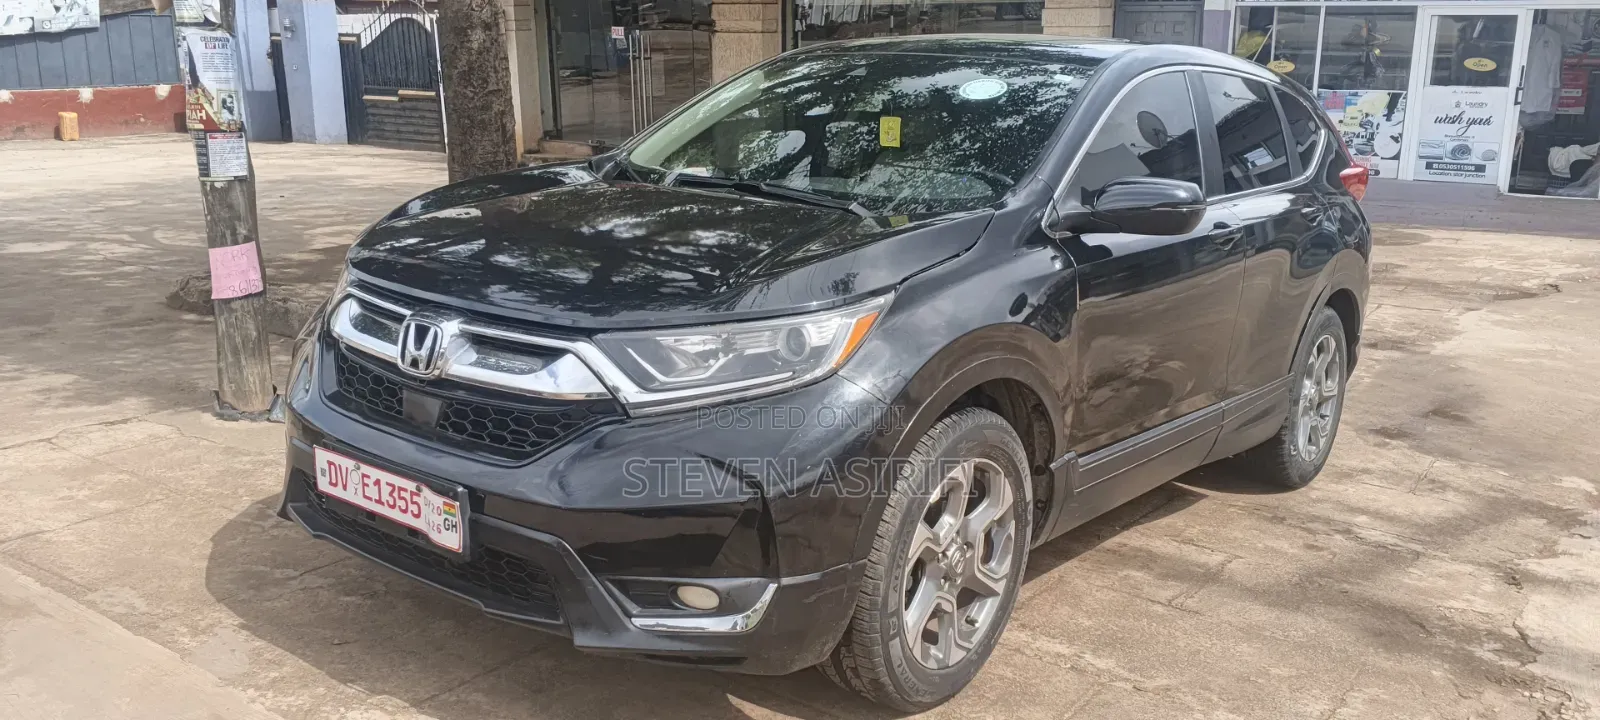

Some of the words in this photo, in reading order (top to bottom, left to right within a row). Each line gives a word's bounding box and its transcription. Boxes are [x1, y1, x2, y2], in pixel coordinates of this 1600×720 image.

[1434, 110, 1466, 124] wash
[327, 460, 348, 491] DV
[361, 472, 422, 519] E1355
[443, 517, 458, 534] GH
